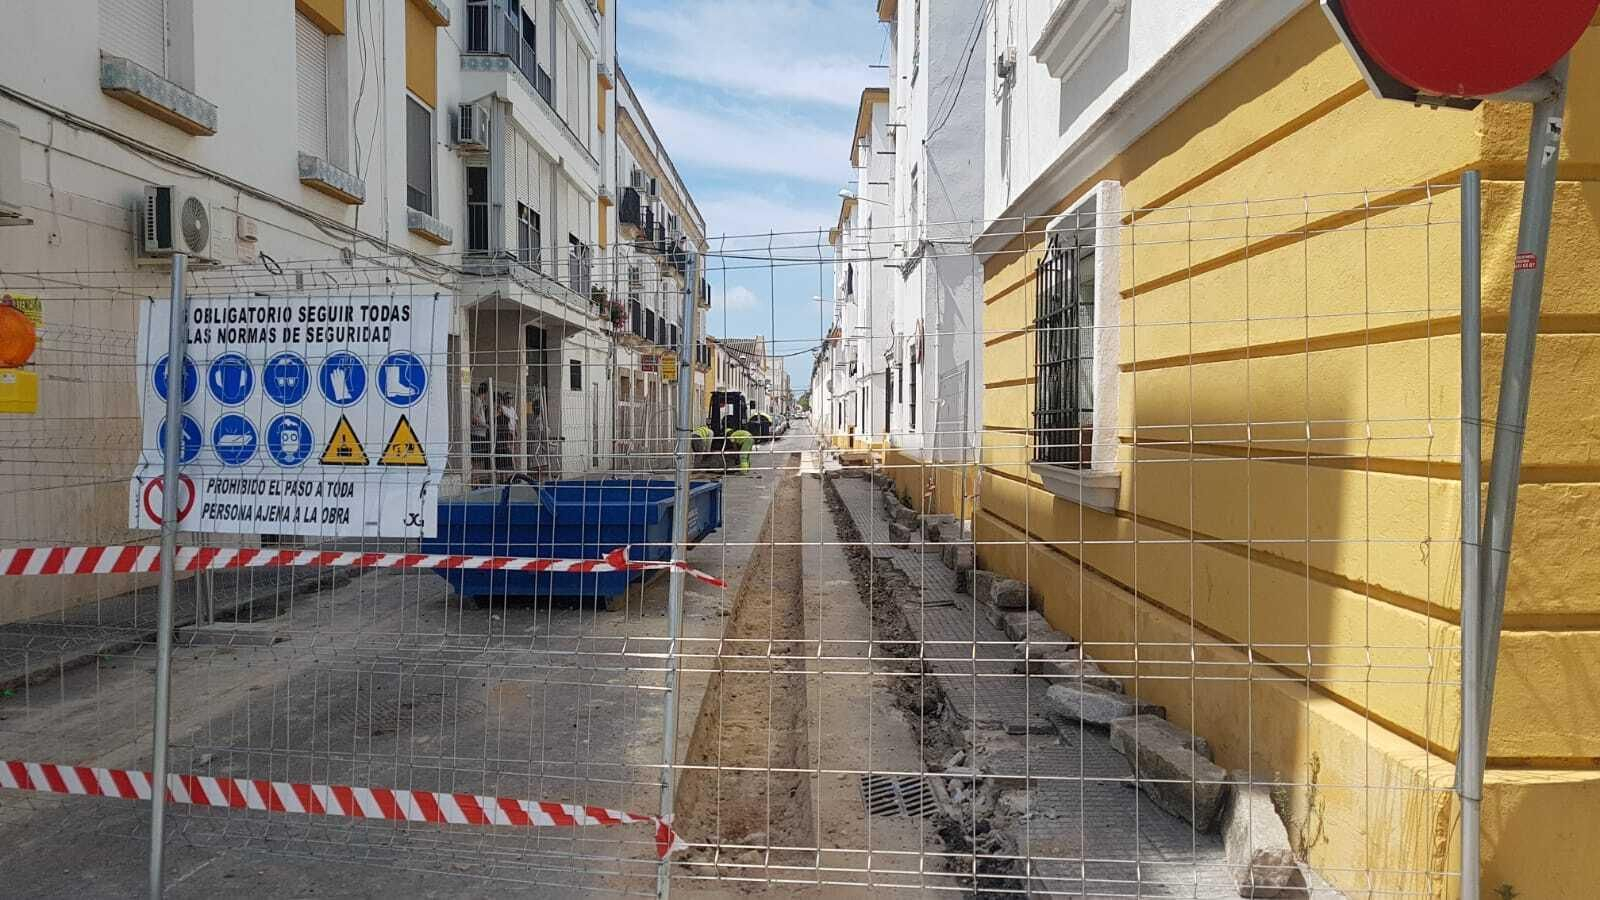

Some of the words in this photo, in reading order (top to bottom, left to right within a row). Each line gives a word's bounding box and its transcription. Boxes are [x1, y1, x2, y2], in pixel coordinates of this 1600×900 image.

[193, 306, 292, 324] OBLIGATORIO
[298, 305, 354, 323] SEGUIR
[360, 305, 410, 322] TODAS
[187, 327, 212, 344] LAS
[217, 327, 277, 344] NORMAS
[283, 327, 301, 343] DE
[306, 326, 391, 343] SEGURIDAD
[206, 478, 266, 496] PROHIBIDO
[268, 480, 281, 496] EL
[284, 480, 313, 497] PASO
[315, 482, 324, 497] A
[327, 481, 355, 498] TODA
[201, 503, 252, 521] PERSONA
[254, 505, 290, 523] AJENA
[292, 506, 301, 523] A
[303, 507, 317, 523] LA
[321, 507, 350, 524] OBRA
